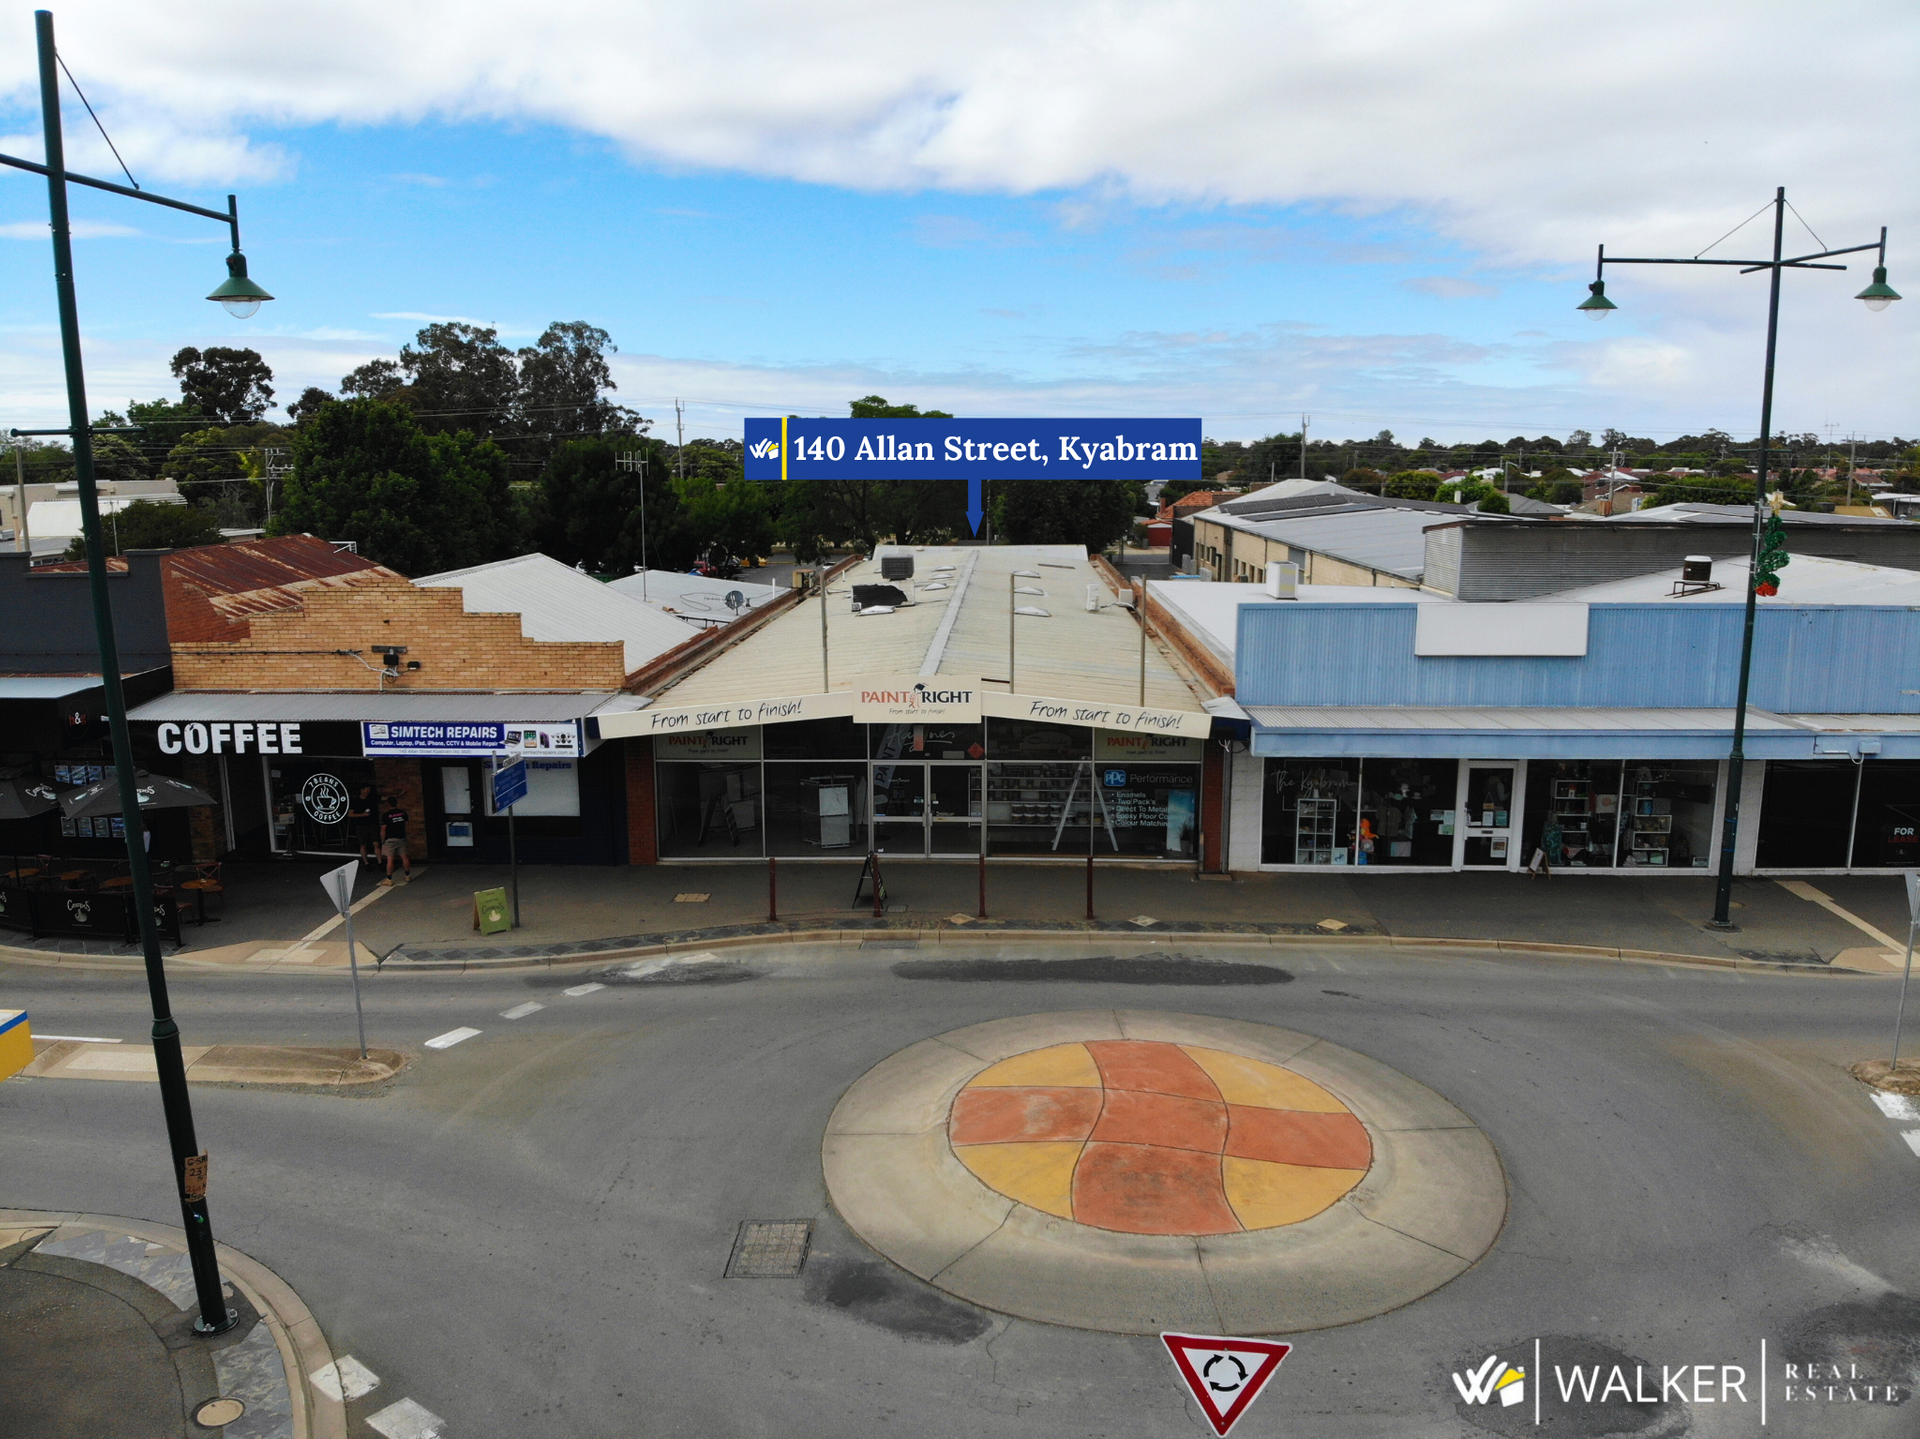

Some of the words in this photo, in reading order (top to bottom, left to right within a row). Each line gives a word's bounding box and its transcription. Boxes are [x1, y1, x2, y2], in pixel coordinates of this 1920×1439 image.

[861, 691, 910, 703] PAINT
[921, 691, 973, 703] RIGHT
[651, 713, 689, 729] From
[695, 709, 732, 726] start
[738, 708, 752, 721] to
[758, 698, 803, 722] finish!
[1029, 701, 1067, 717] From
[1072, 708, 1111, 722] start
[1115, 712, 1131, 724] to
[1135, 711, 1184, 729] finish!
[391, 726, 443, 739] SIMTECH
[447, 726, 498, 739] REPAIRS
[157, 722, 303, 755] COFFEE
[668, 736, 704, 745] PAINT
[711, 736, 748, 745] RIGHT
[1107, 737, 1143, 747] PAINT
[1151, 737, 1188, 747] RIGHT
[531, 761, 572, 771] Repairs
[1105, 771, 1125, 784] PPG
[1130, 773, 1193, 784] Performance
[313, 810, 341, 821] COFFEE
[1894, 827, 1915, 836] FOR
[1887, 835, 1919, 843] LEASE
